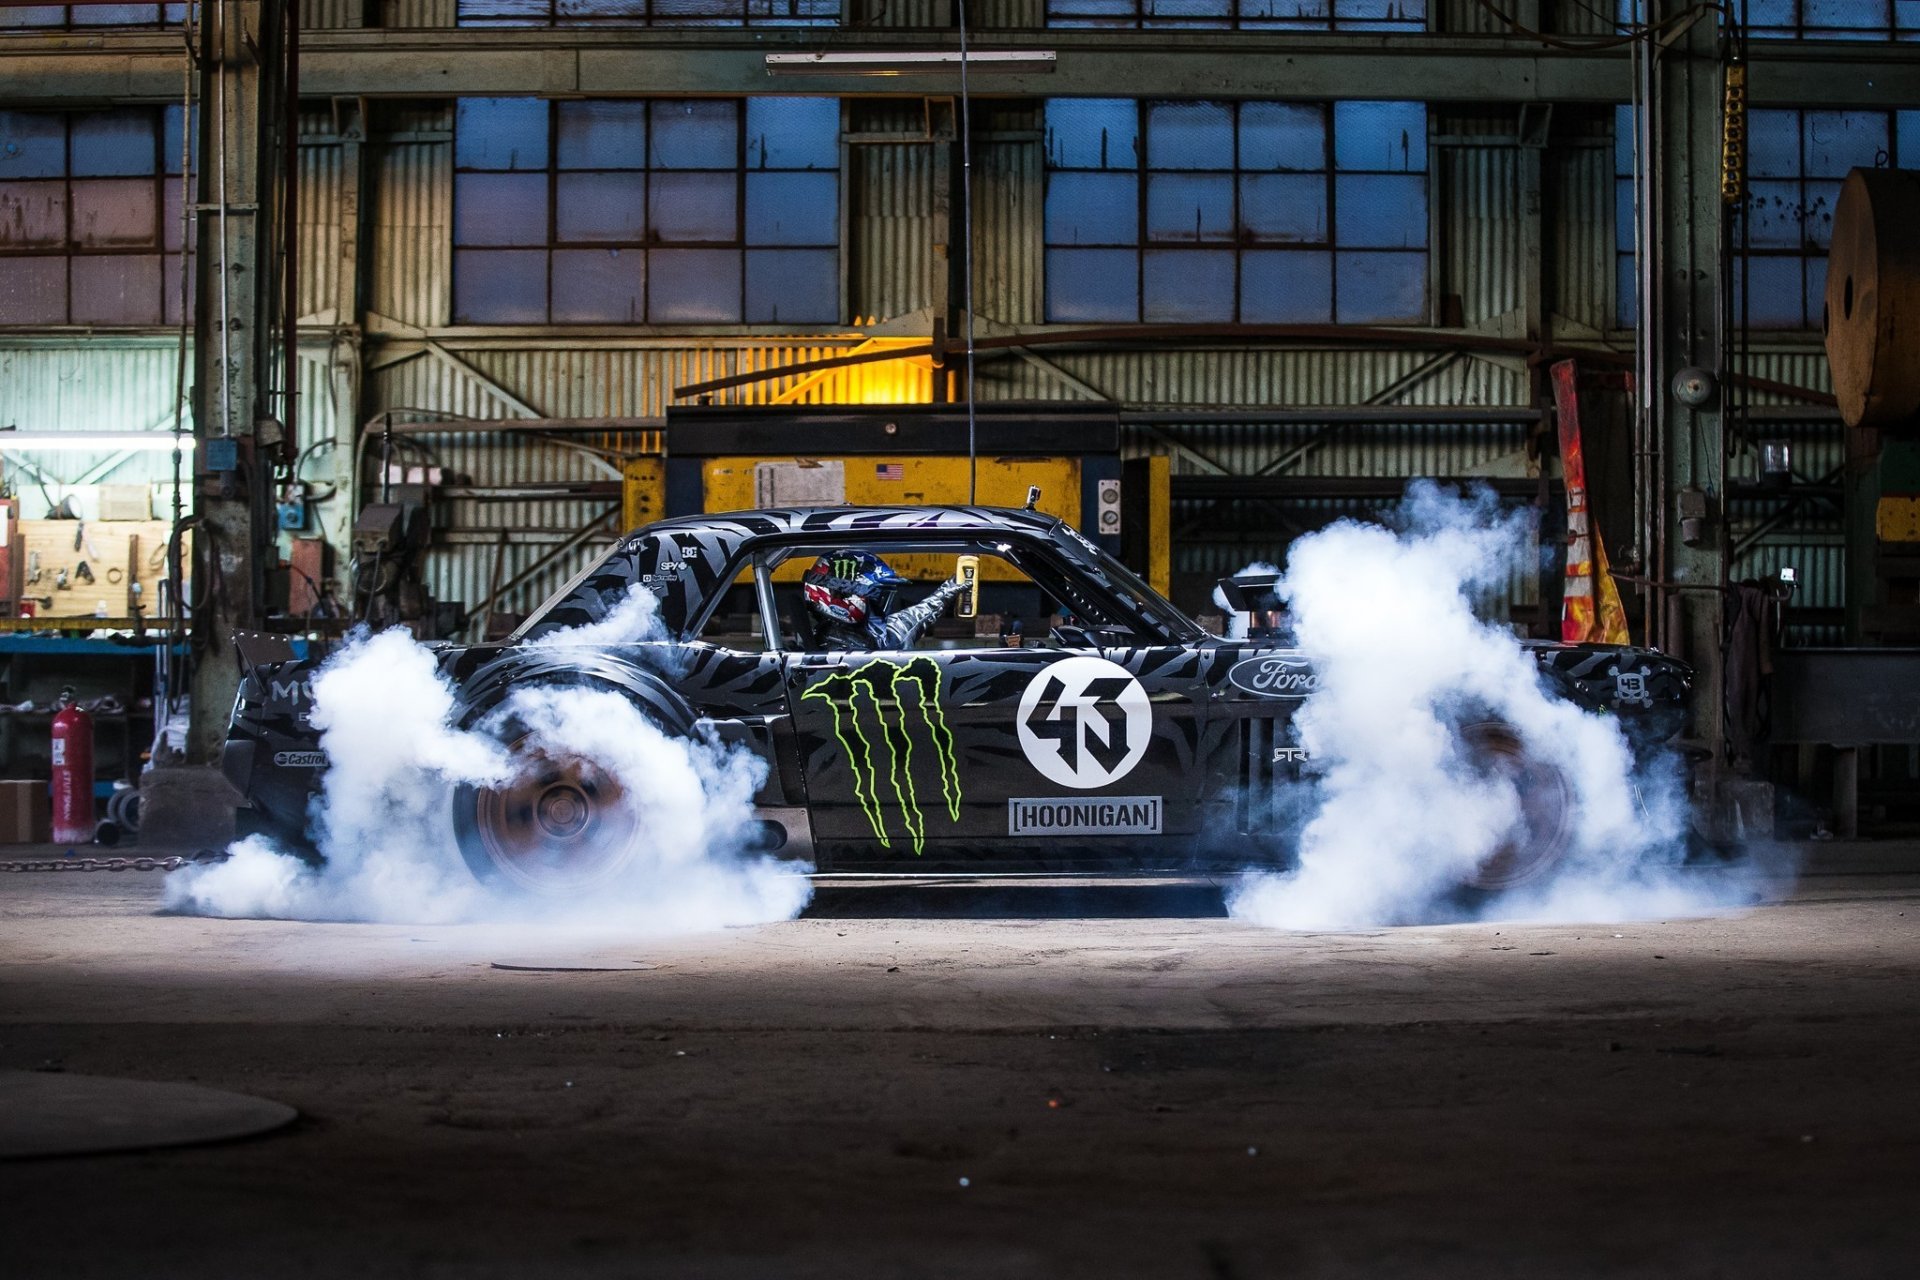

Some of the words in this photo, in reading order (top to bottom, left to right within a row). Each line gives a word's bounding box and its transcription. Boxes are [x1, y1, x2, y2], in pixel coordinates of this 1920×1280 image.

[682, 547, 698, 559] DC
[1620, 677, 1641, 691] 43
[1025, 675, 1134, 776] 43
